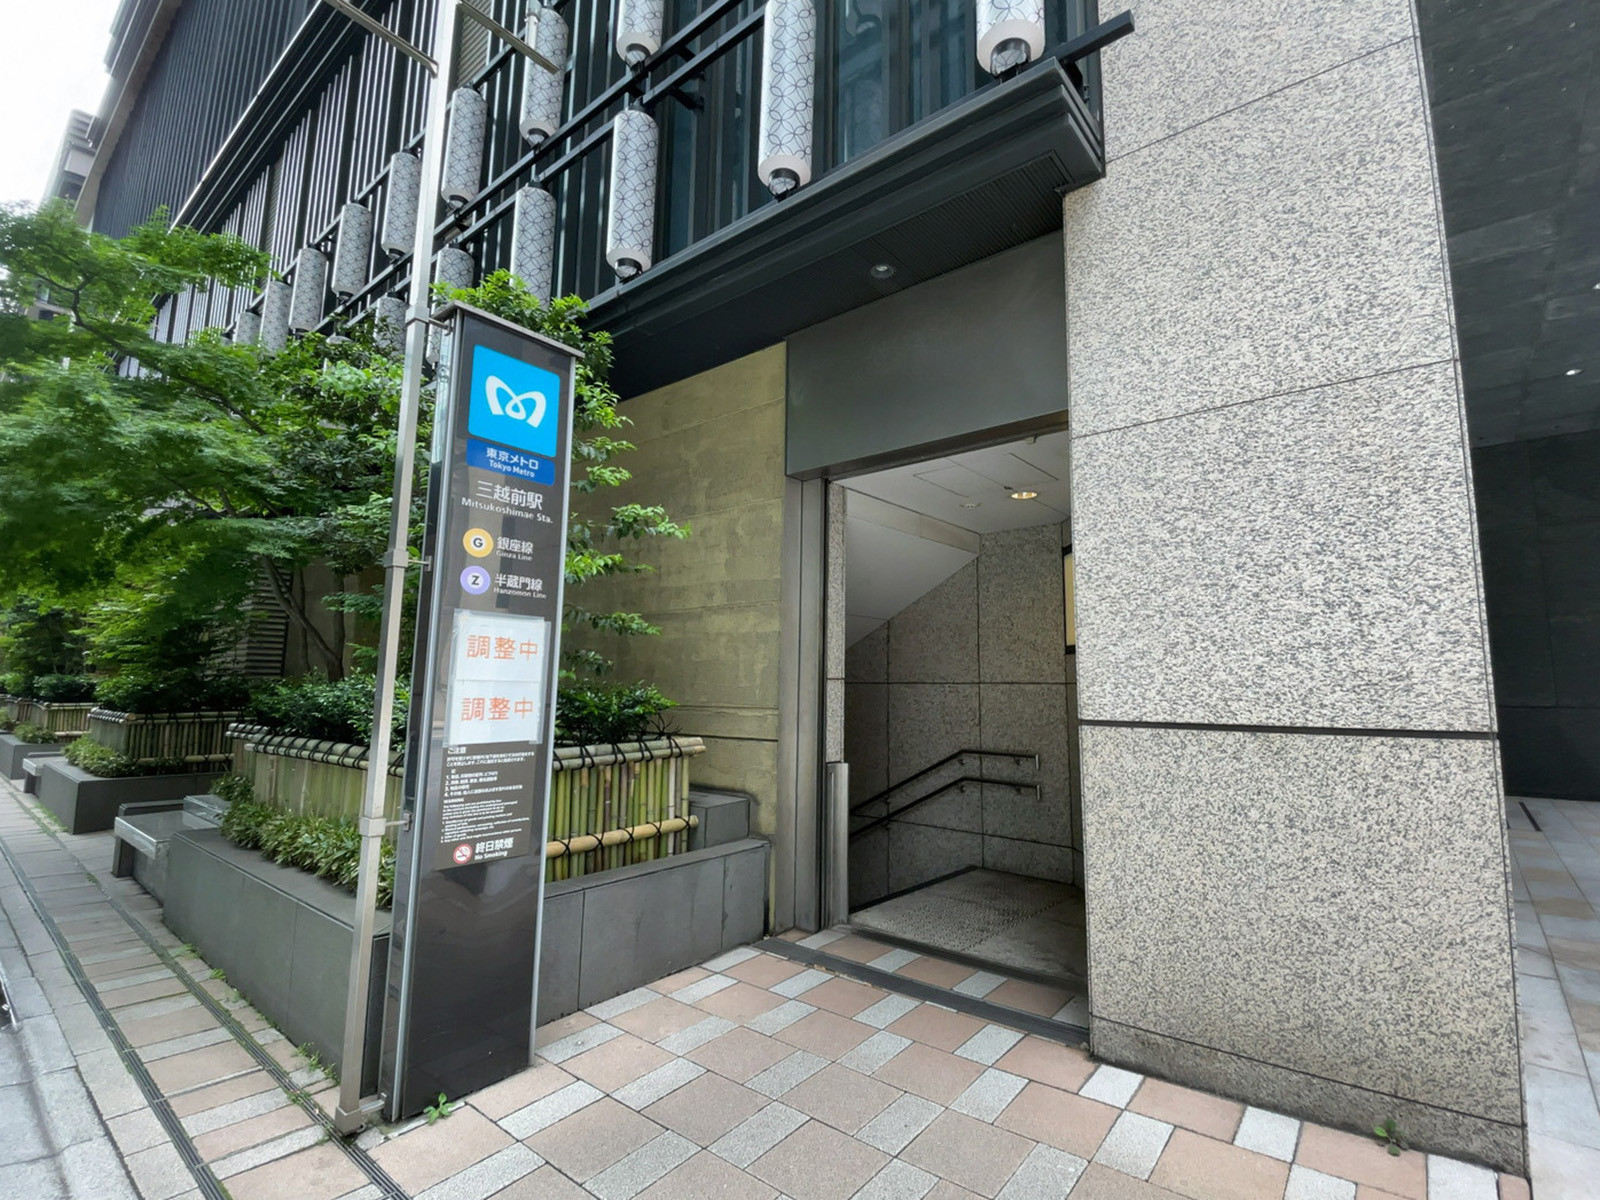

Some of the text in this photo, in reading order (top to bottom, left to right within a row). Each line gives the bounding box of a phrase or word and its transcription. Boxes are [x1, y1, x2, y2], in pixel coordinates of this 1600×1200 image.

[485, 446, 539, 471] 東京メトロ
[489, 459, 535, 478] Tokyo Metro
[476, 480, 543, 511] 三越前駅
[461, 497, 554, 524] Mitsukoshimae Sta.
[472, 536, 534, 555] G 銀座線
[495, 550, 533, 562] Ginza Line
[471, 573, 543, 591] Z 半蔵門線
[493, 586, 547, 599] Hanzomon Line
[466, 634, 539, 661] 調整中
[461, 697, 534, 721] 調整中
[475, 837, 515, 854] 終日禁煙
[474, 850, 509, 861] No Smoking
